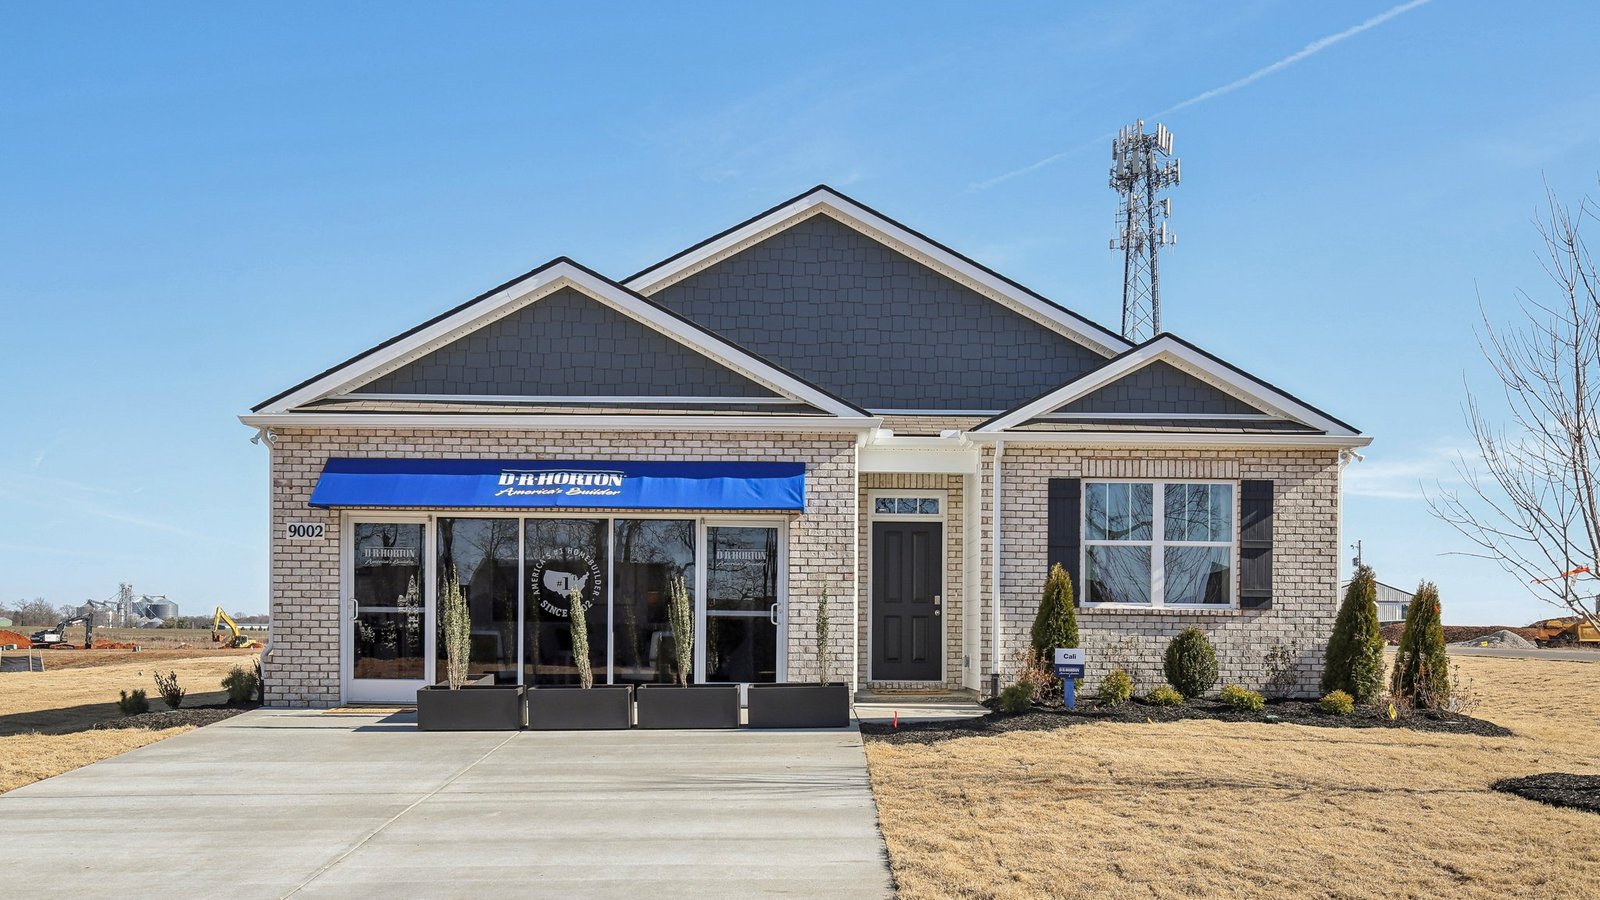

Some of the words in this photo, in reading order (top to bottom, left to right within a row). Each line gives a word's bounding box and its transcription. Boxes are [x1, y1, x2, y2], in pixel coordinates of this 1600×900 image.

[495, 487, 563, 496] America's
[565, 487, 621, 496] Builder
[288, 524, 324, 538] 9002
[531, 552, 552, 595] AMERICA'S
[567, 547, 602, 597] HOMEBUILDER
[556, 576, 571, 591] #1
[540, 599, 568, 618] SINCE
